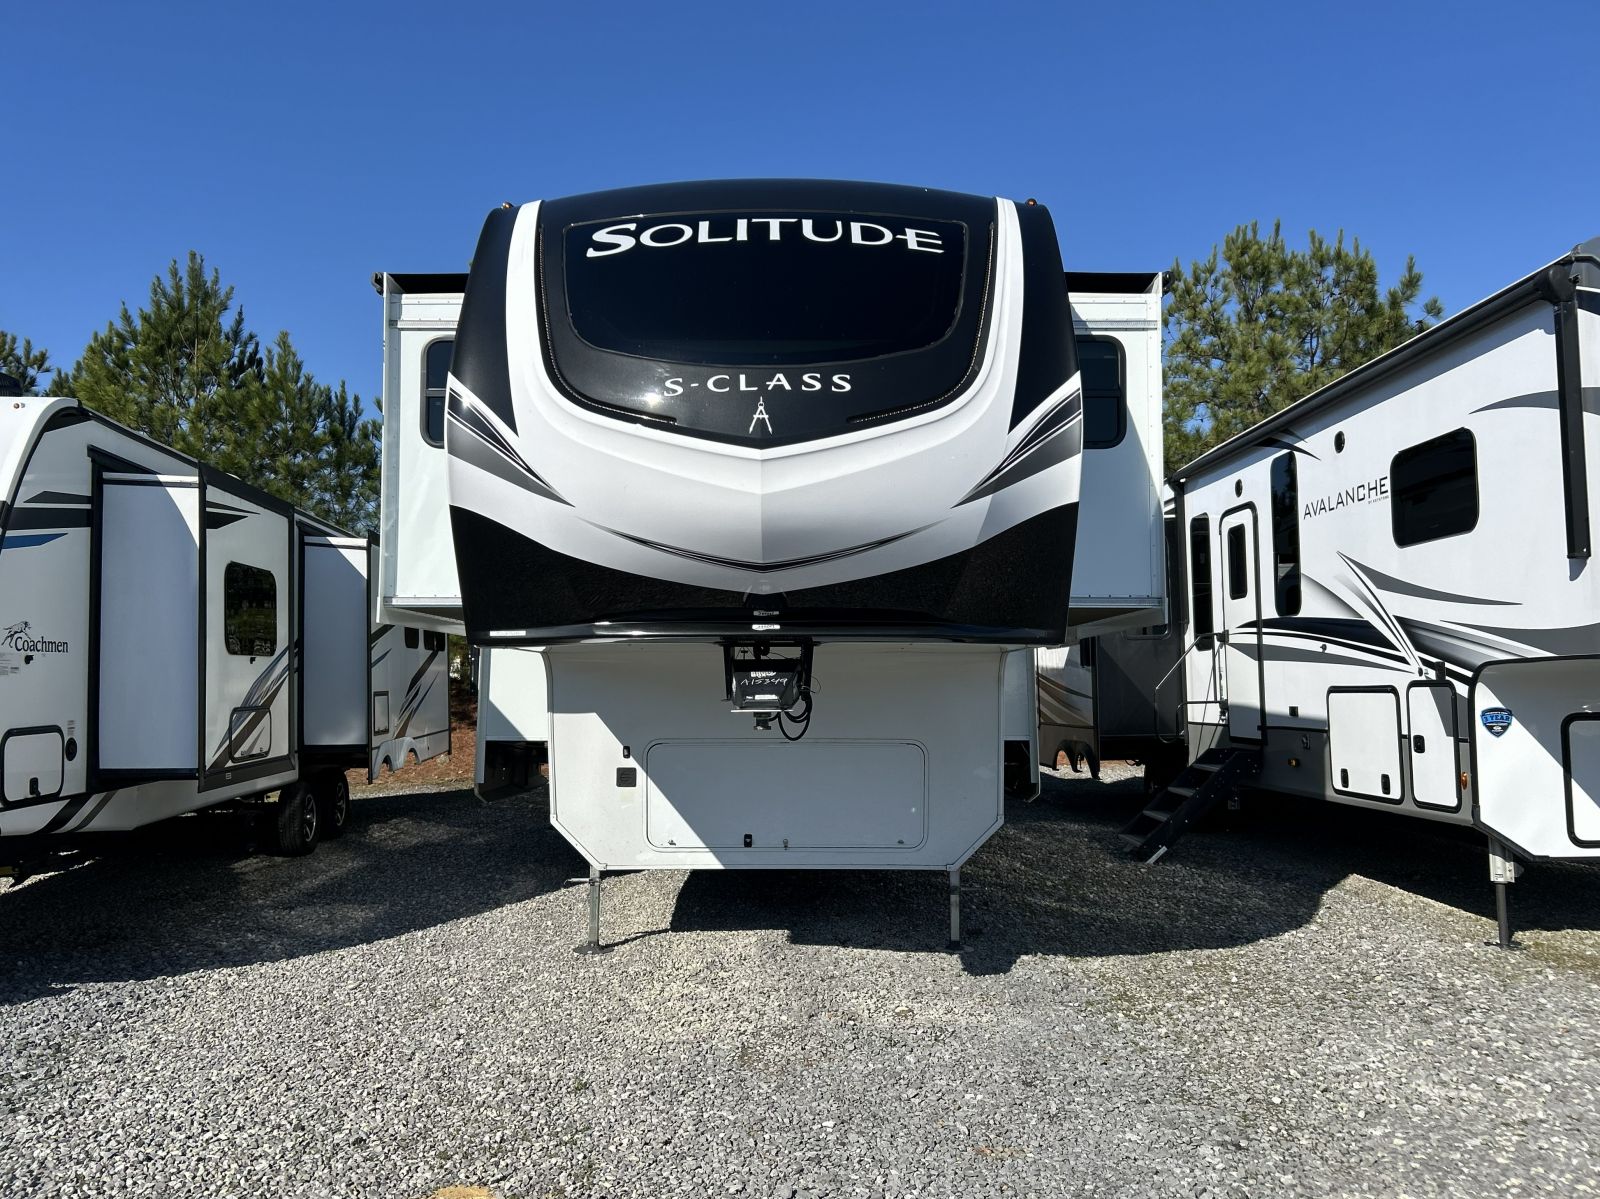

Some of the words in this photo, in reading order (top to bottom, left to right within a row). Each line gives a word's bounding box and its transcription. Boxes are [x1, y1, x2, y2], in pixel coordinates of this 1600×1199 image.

[586, 218, 945, 258] SOLITUDE
[663, 372, 853, 397] S-CLASS
[1304, 476, 1389, 520] AVALANCHE
[15, 635, 69, 653] Coachmen
[1490, 714, 1511, 722] YEAR
